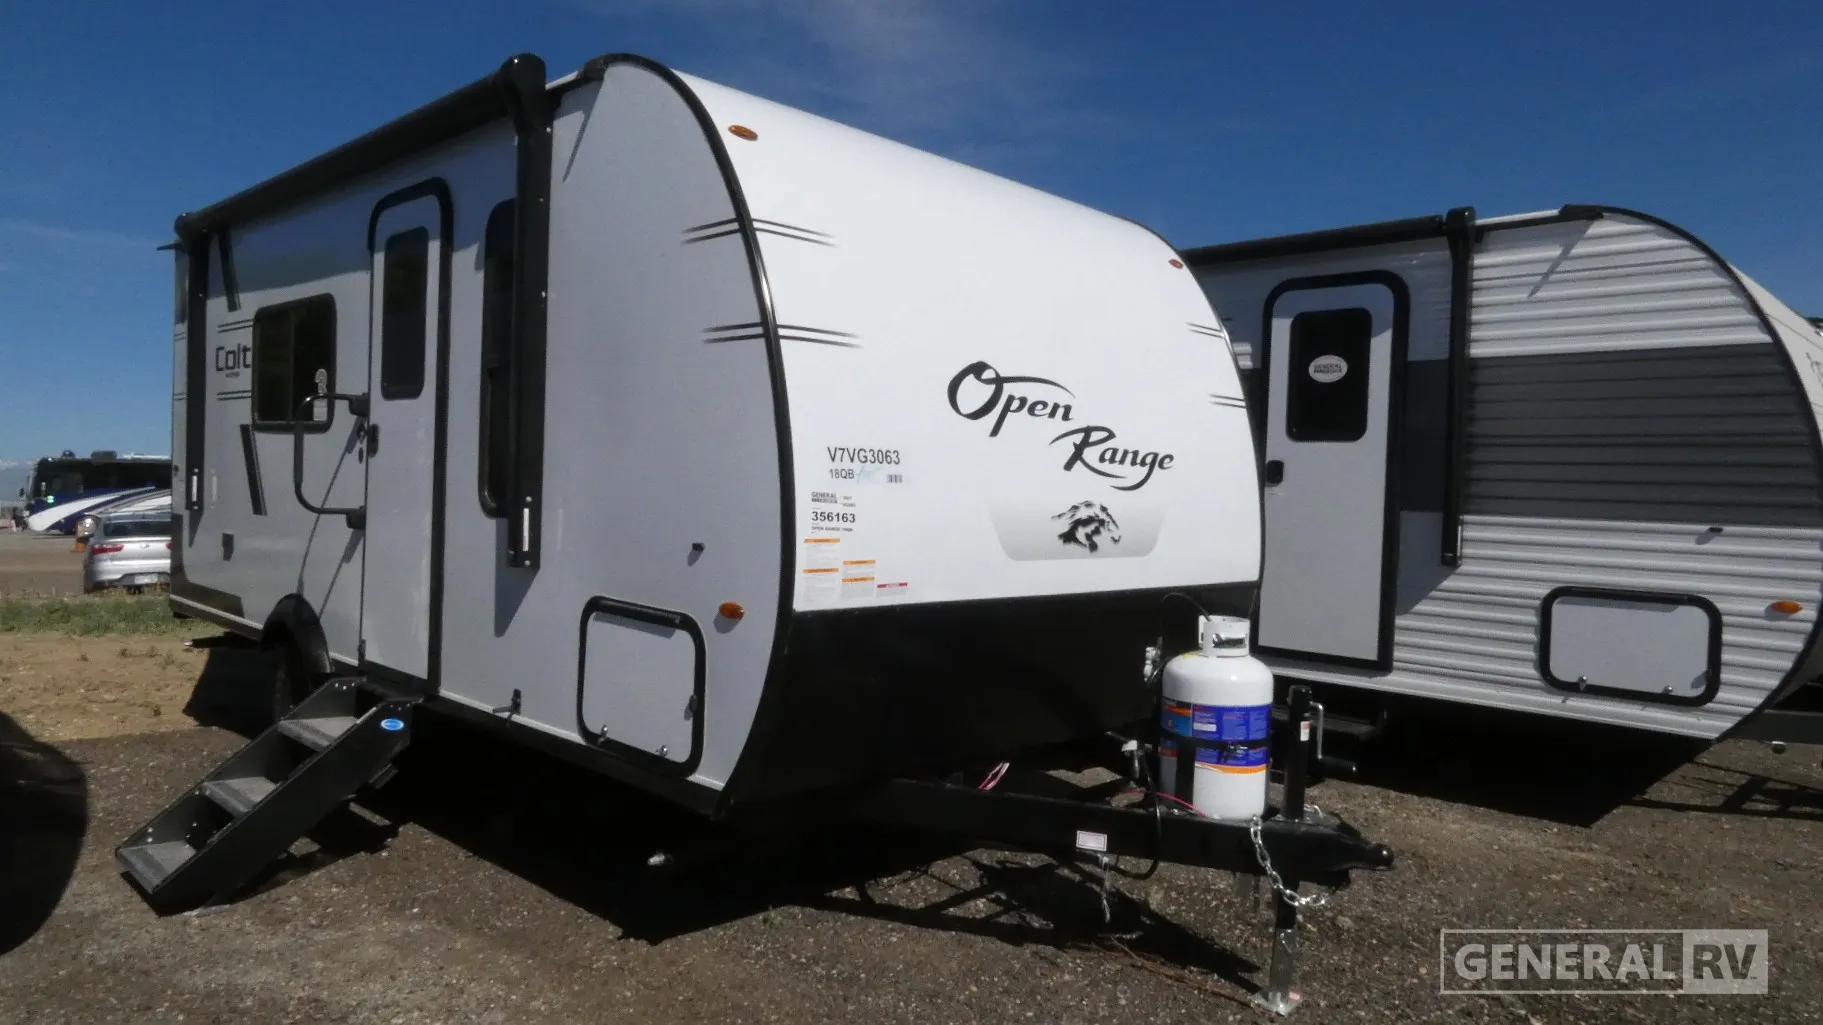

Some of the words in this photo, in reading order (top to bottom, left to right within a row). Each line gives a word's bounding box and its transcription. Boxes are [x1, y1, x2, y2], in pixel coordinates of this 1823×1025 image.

[216, 343, 251, 371] Colt
[947, 360, 1076, 437] Open
[827, 446, 901, 465] V7VG3063
[1049, 424, 1174, 491] Range
[829, 468, 855, 480] 18QB
[811, 511, 856, 523] 356163
